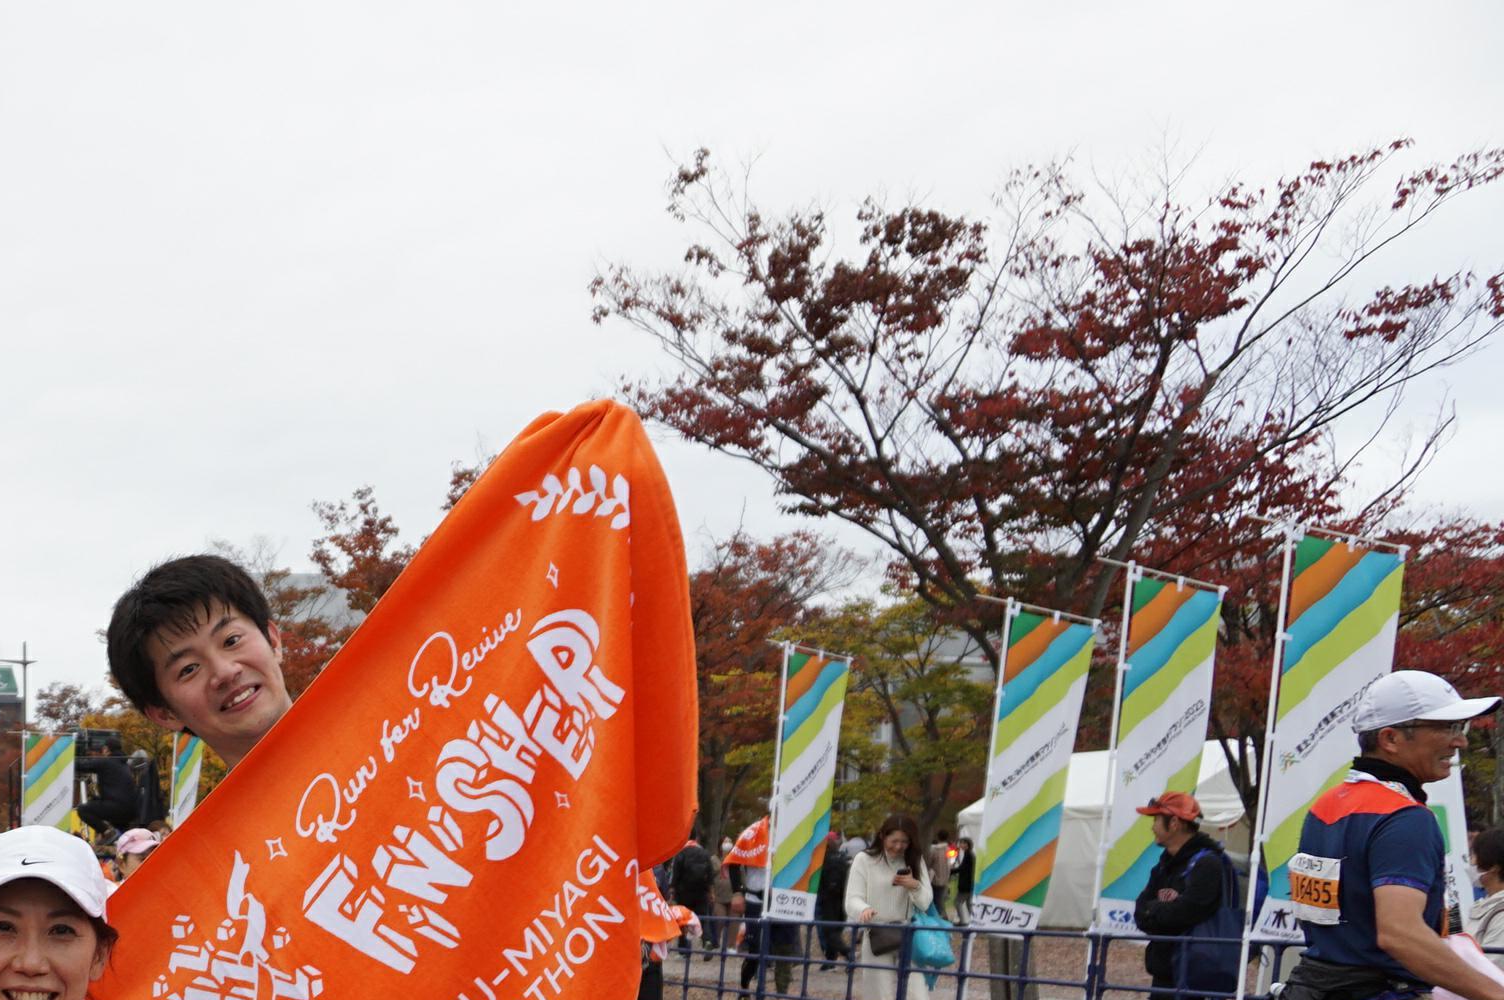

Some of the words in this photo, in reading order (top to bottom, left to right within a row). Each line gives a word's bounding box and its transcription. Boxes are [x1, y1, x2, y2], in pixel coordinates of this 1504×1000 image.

[296, 755, 378, 844] Run
[379, 707, 421, 763] for
[407, 607, 522, 708] Revive
